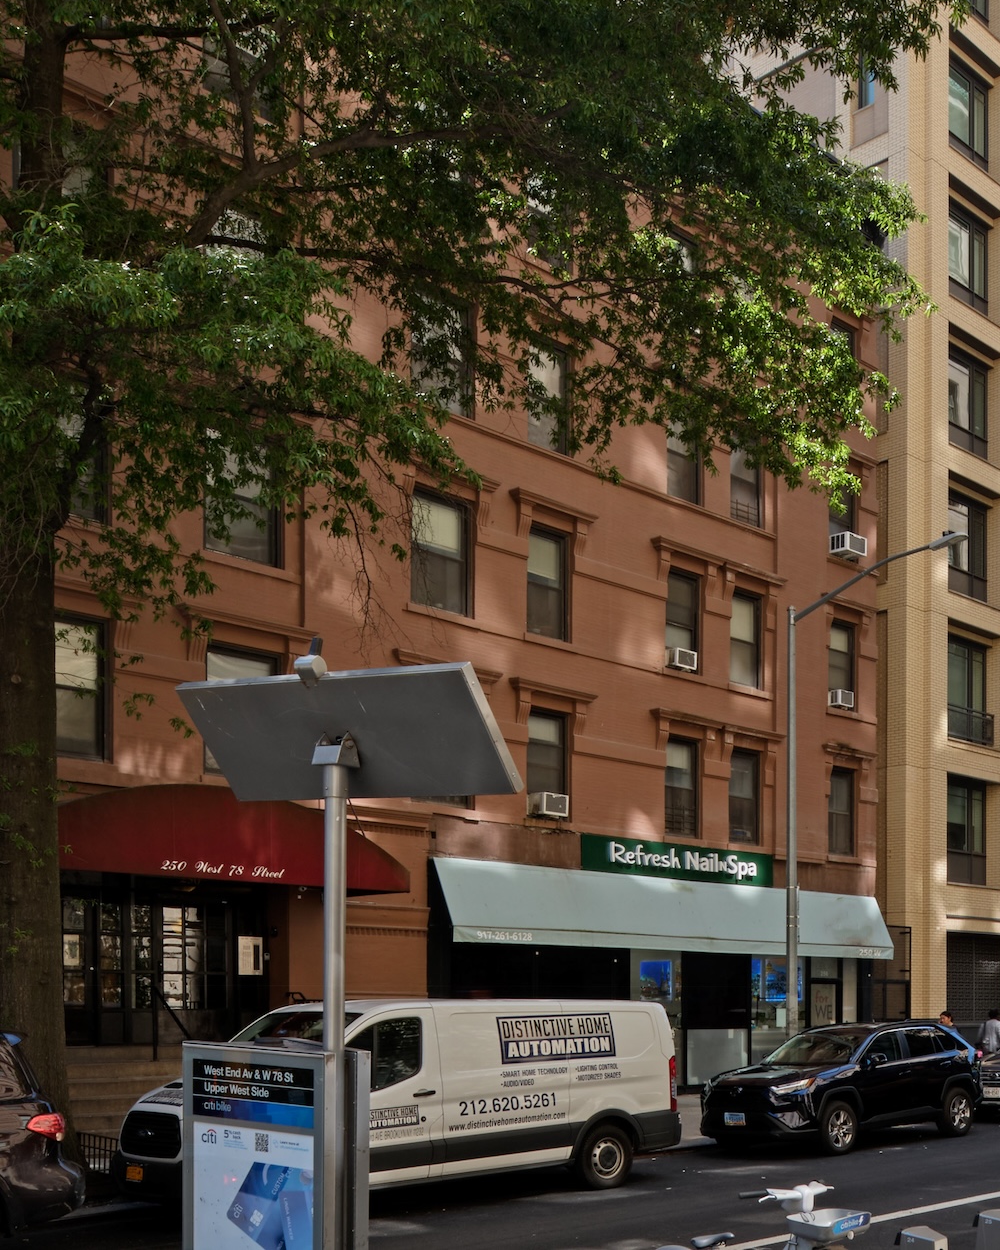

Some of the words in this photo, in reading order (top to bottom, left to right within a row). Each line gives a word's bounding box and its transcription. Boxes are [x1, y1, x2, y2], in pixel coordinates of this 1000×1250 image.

[609, 841, 681, 869] Refresh
[160, 860, 187, 871] 250
[195, 861, 224, 874] West
[228, 865, 244, 877] 78
[251, 866, 285, 879] Street
[476, 930, 533, 941] 917-261-6128
[859, 948, 873, 957] 250
[502, 1018, 575, 1039] DISTINCTIVE
[577, 1016, 610, 1035] HOME
[507, 1036, 611, 1058] AUTOMATION
[203, 1065, 224, 1077] West
[225, 1068, 241, 1078] End
[242, 1069, 253, 1079] Av
[254, 1070, 261, 1080] &
[262, 1070, 271, 1080] W
[272, 1071, 283, 1082] 78
[283, 1072, 294, 1083] St
[537, 1067, 568, 1076] TECHNOLOGY
[598, 1063, 618, 1071] CONTROL
[203, 1081, 228, 1094] Upper
[229, 1083, 250, 1096] West
[250, 1086, 270, 1098] Side
[459, 1092, 556, 1116] 212.620.5261
[370, 1109, 399, 1120] STINCTIVE
[400, 1106, 417, 1116] HOME
[448, 1111, 566, 1132] www.distinctivehomeautomation.com
[201, 1130, 217, 1145] citi
[271, 1172, 285, 1196] CUSTOM
[233, 1203, 243, 1219] citi
[906, 1236, 915, 1244] 24
